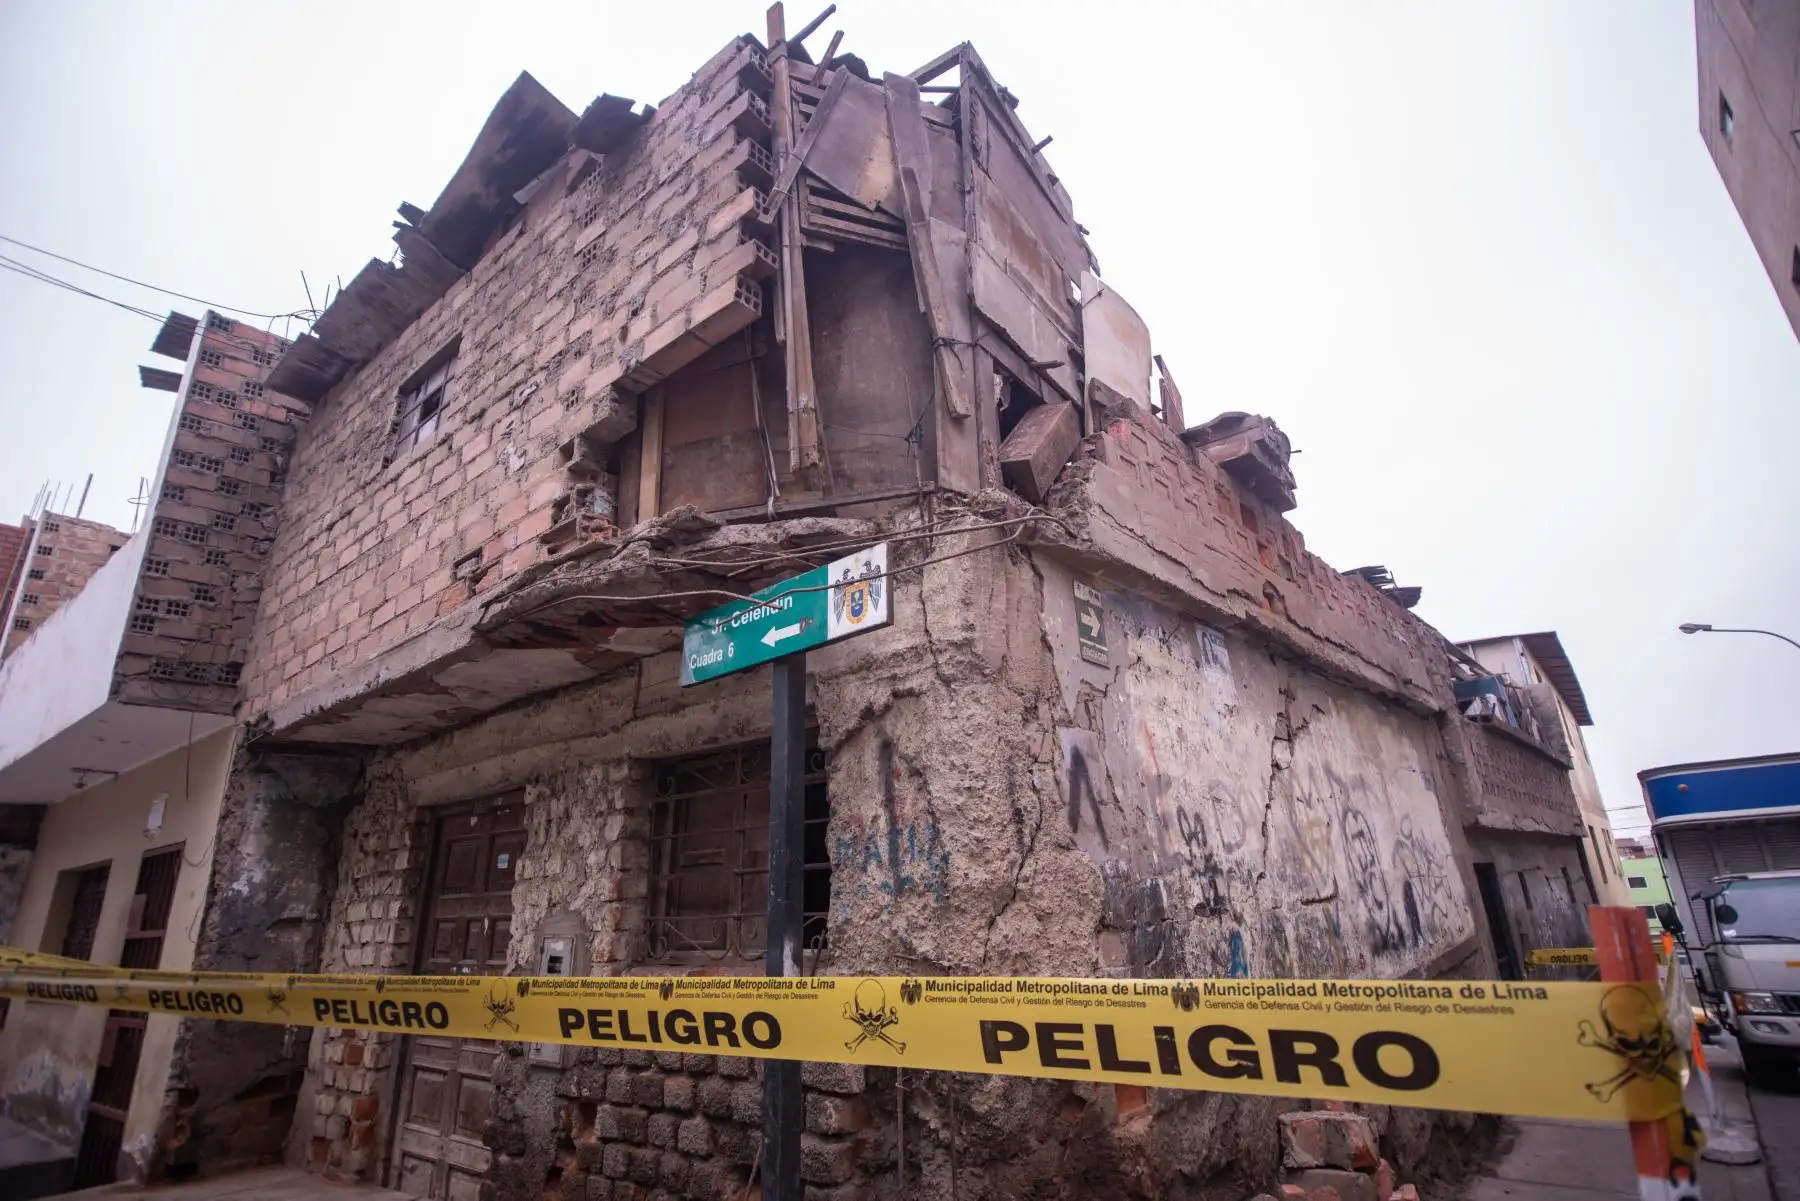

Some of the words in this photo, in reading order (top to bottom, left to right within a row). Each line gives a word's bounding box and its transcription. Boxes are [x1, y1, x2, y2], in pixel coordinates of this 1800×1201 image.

[690, 648, 723, 669] Cuadra
[728, 642, 734, 657] 6
[27, 981, 98, 1003] PELIGRO
[532, 979, 579, 990] Municipalidad
[581, 980, 628, 990] Metropolitana
[630, 980, 638, 989] de
[640, 980, 658, 990] Lima
[676, 979, 730, 990] Municipalidad
[733, 979, 793, 992] Metropolitana
[796, 978, 808, 989] de
[810, 978, 835, 989] Lima
[926, 980, 1012, 994] Municipalidad
[1016, 980, 1108, 996] Metropolitana
[1112, 983, 1128, 995] de
[1134, 983, 1168, 996] Lima
[1204, 982, 1317, 1000] Municipalidad
[1323, 983, 1452, 1000] Metropolitana
[1459, 984, 1485, 999] de
[1492, 984, 1548, 1000] Lima
[148, 989, 244, 1015] PELIGRO
[925, 995, 956, 1003] Gerencia
[959, 996, 968, 1004] de
[970, 996, 998, 1004] Defensa
[1000, 996, 1014, 1004] Civil
[1017, 998, 1021, 1007] y
[1023, 996, 1050, 1005] Gestión
[1052, 997, 1063, 1005] del
[1066, 998, 1092, 1008] Riesgo
[1094, 998, 1104, 1006] de
[1106, 999, 1146, 1008] Desastres
[1204, 1000, 1244, 1009] Gerencia
[1246, 1000, 1258, 1010] de
[1260, 1000, 1300, 1010] Defensa
[1302, 1001, 1323, 1010] Civil
[1326, 1003, 1331, 1013] y
[1334, 1001, 1372, 1012] Gestión
[1376, 1003, 1391, 1012] del
[1394, 1003, 1432, 1015] Riesgo
[1435, 1004, 1449, 1013] de
[1452, 1004, 1515, 1014] Desastres
[313, 997, 449, 1030] PELIGRO
[558, 1007, 782, 1050] PELIGRO
[979, 1019, 1440, 1091] PELIGRO
